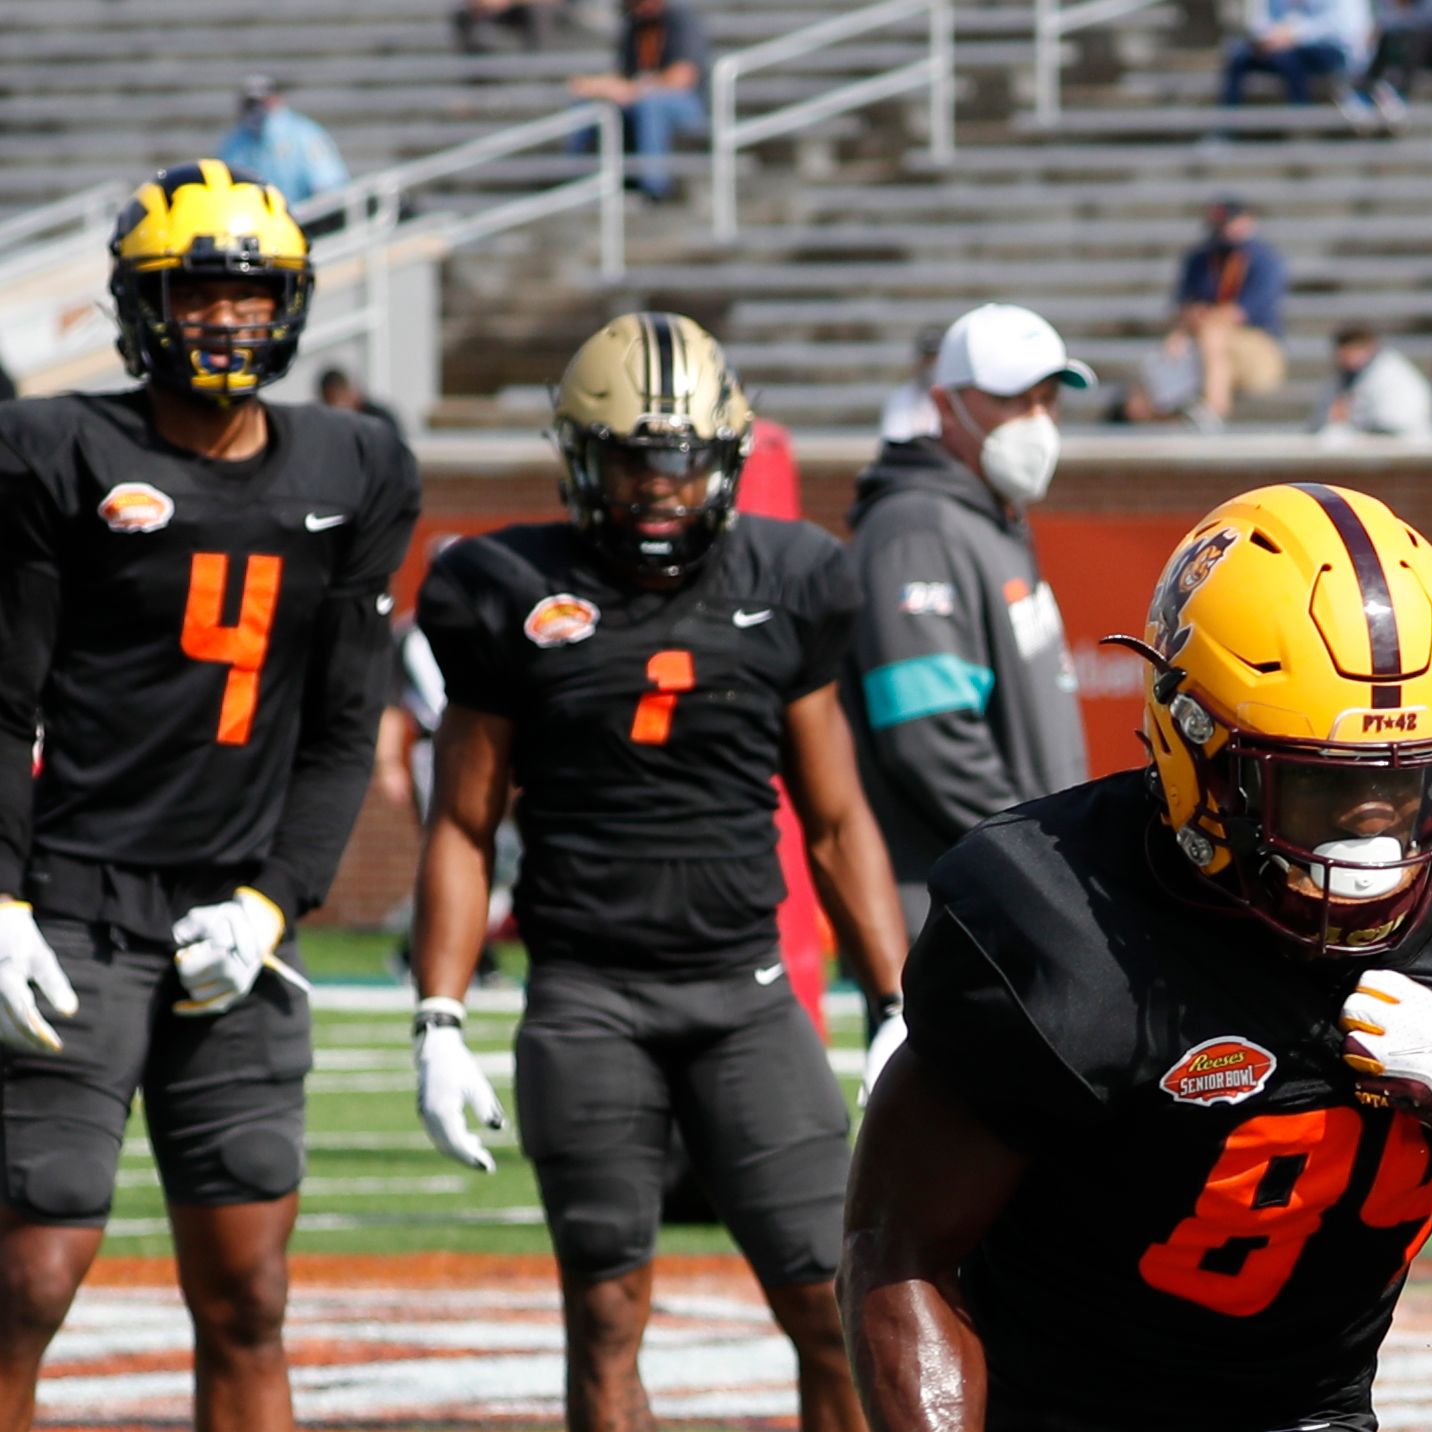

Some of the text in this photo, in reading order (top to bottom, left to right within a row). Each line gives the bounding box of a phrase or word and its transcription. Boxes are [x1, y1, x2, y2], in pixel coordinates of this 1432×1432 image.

[179, 551, 282, 745] 4
[630, 650, 696, 743] 1
[1180, 1065, 1258, 1097] SENIOR BOWL
